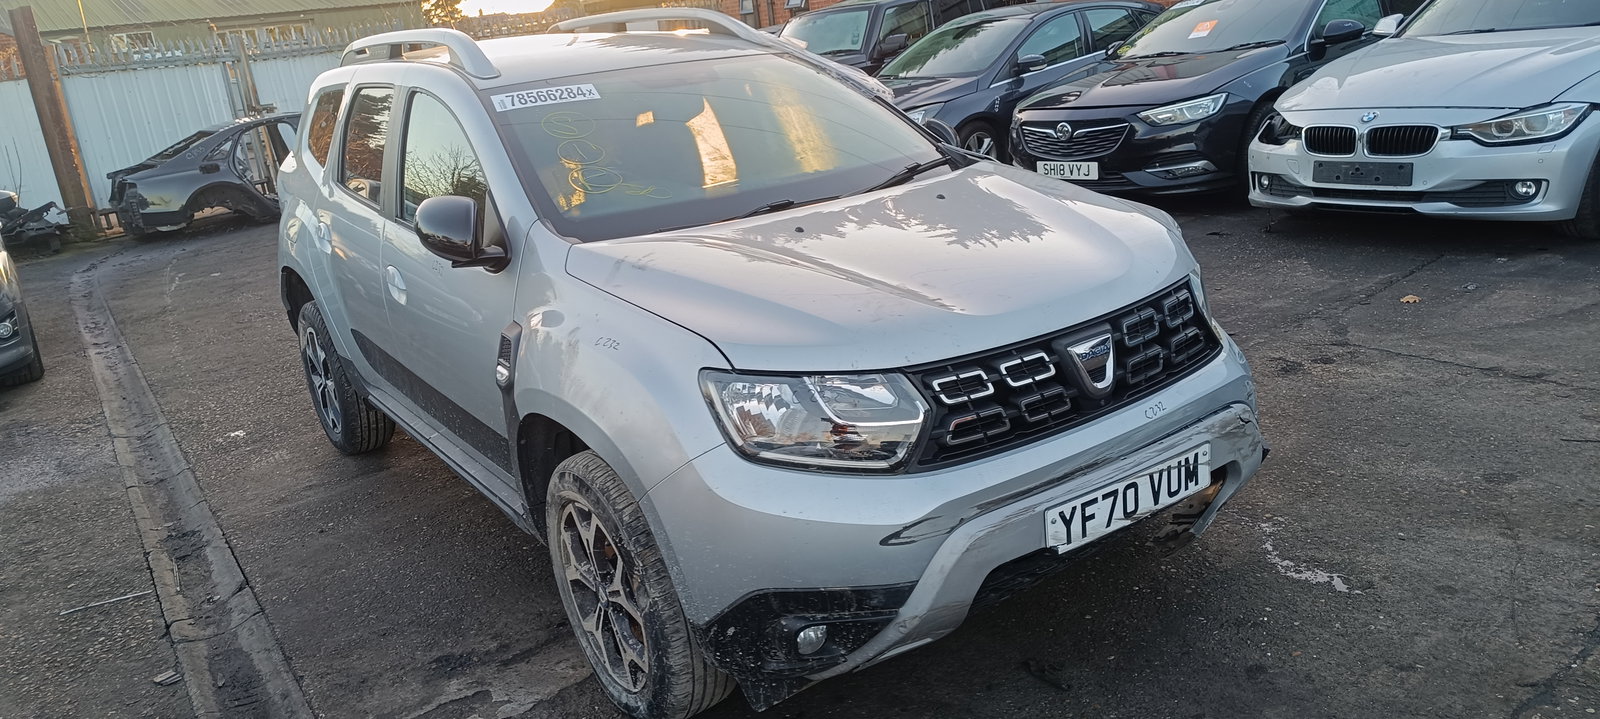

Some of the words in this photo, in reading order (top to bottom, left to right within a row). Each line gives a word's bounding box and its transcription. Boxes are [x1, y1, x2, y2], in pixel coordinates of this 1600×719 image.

[1043, 163, 1066, 176] SH18
[1068, 163, 1090, 177] VYJ
[1058, 481, 1139, 546] YF70
[1149, 451, 1199, 507] VUM
